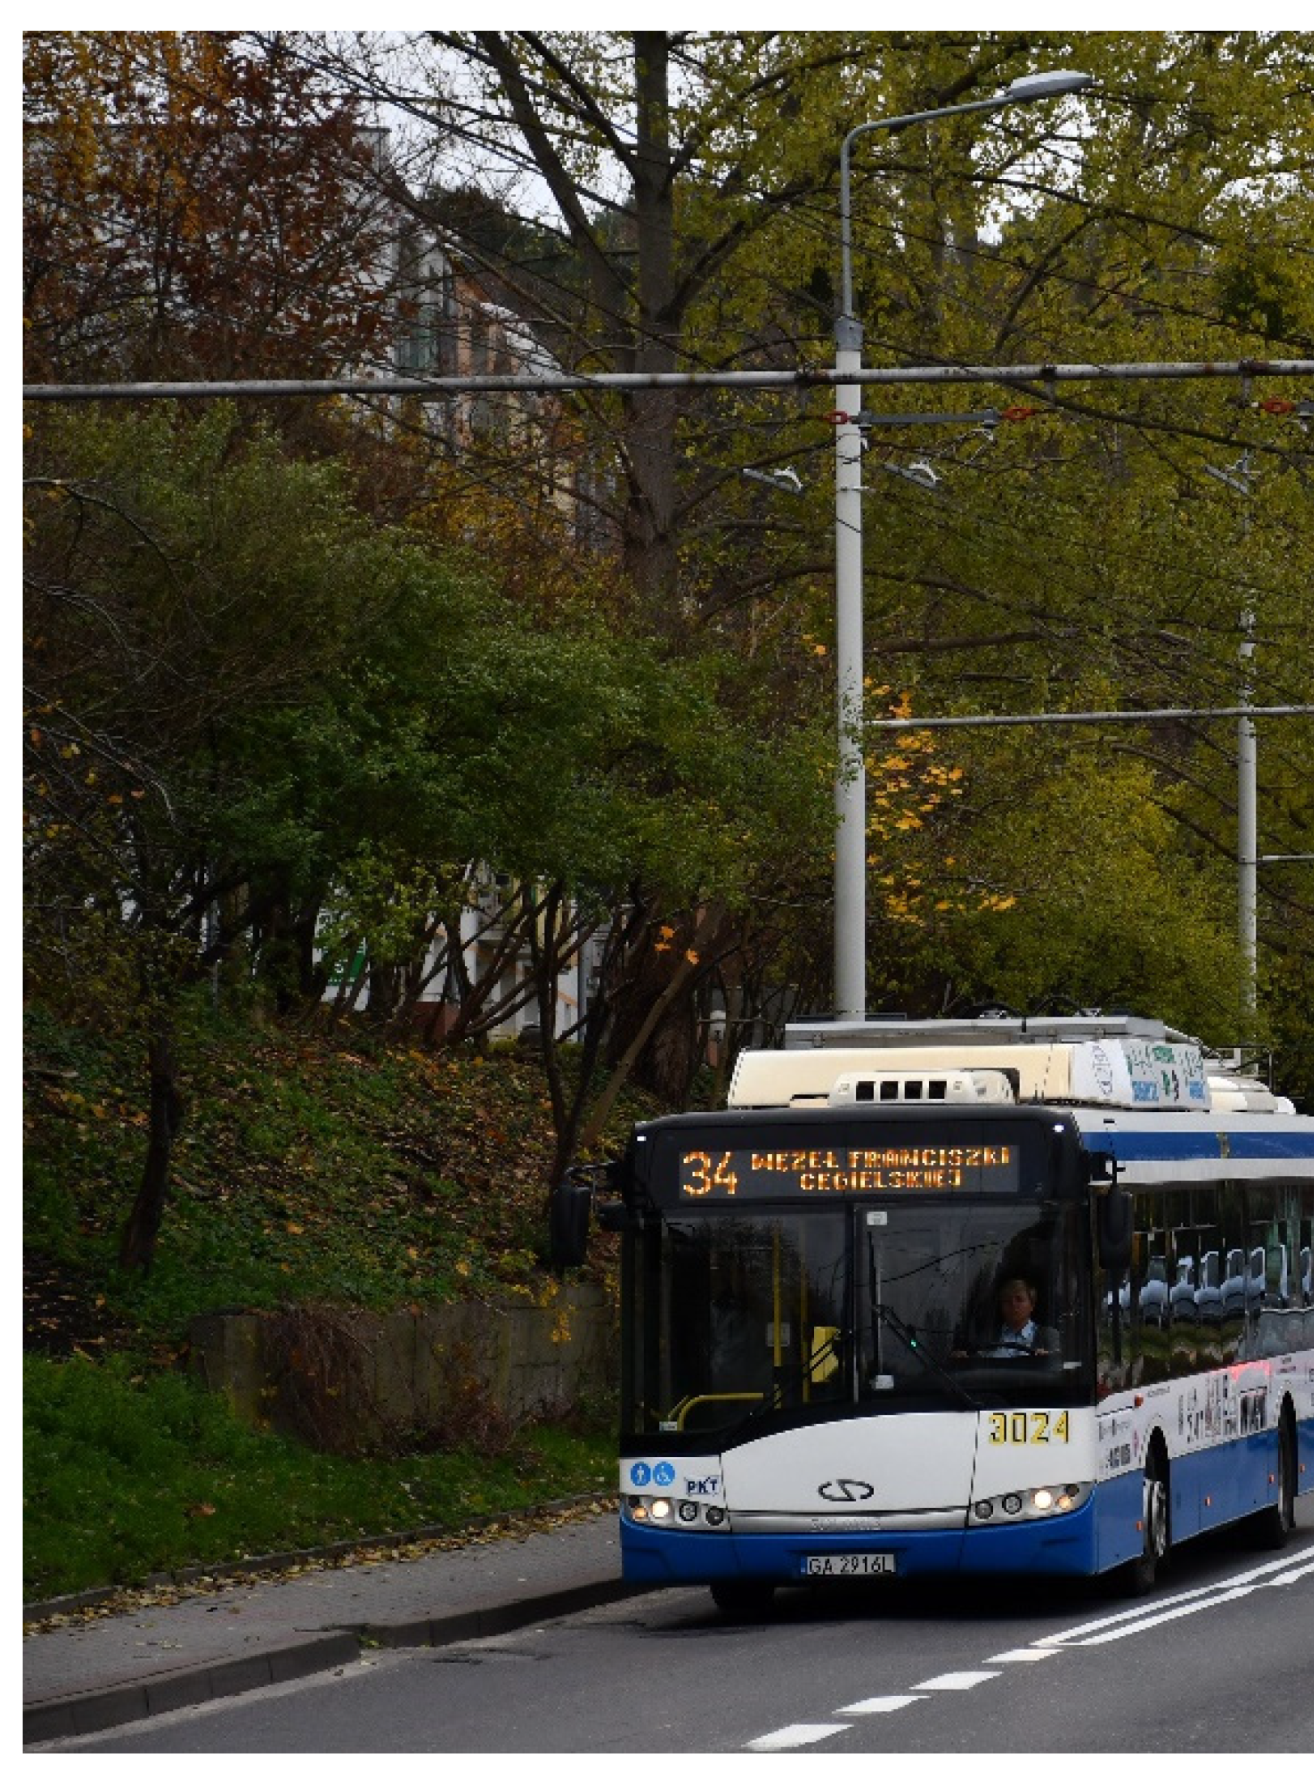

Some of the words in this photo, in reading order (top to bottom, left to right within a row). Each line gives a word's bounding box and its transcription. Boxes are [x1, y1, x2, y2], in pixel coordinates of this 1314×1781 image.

[683, 1151, 738, 1195] 34
[849, 1147, 1010, 1168] FRANCISZKI
[800, 1169, 961, 1190] CEGIELSKIEJ
[988, 1411, 1069, 1446] 3024
[686, 1476, 718, 1493] PKT
[809, 1558, 833, 1576] GA
[840, 1556, 893, 1573] 2916L
